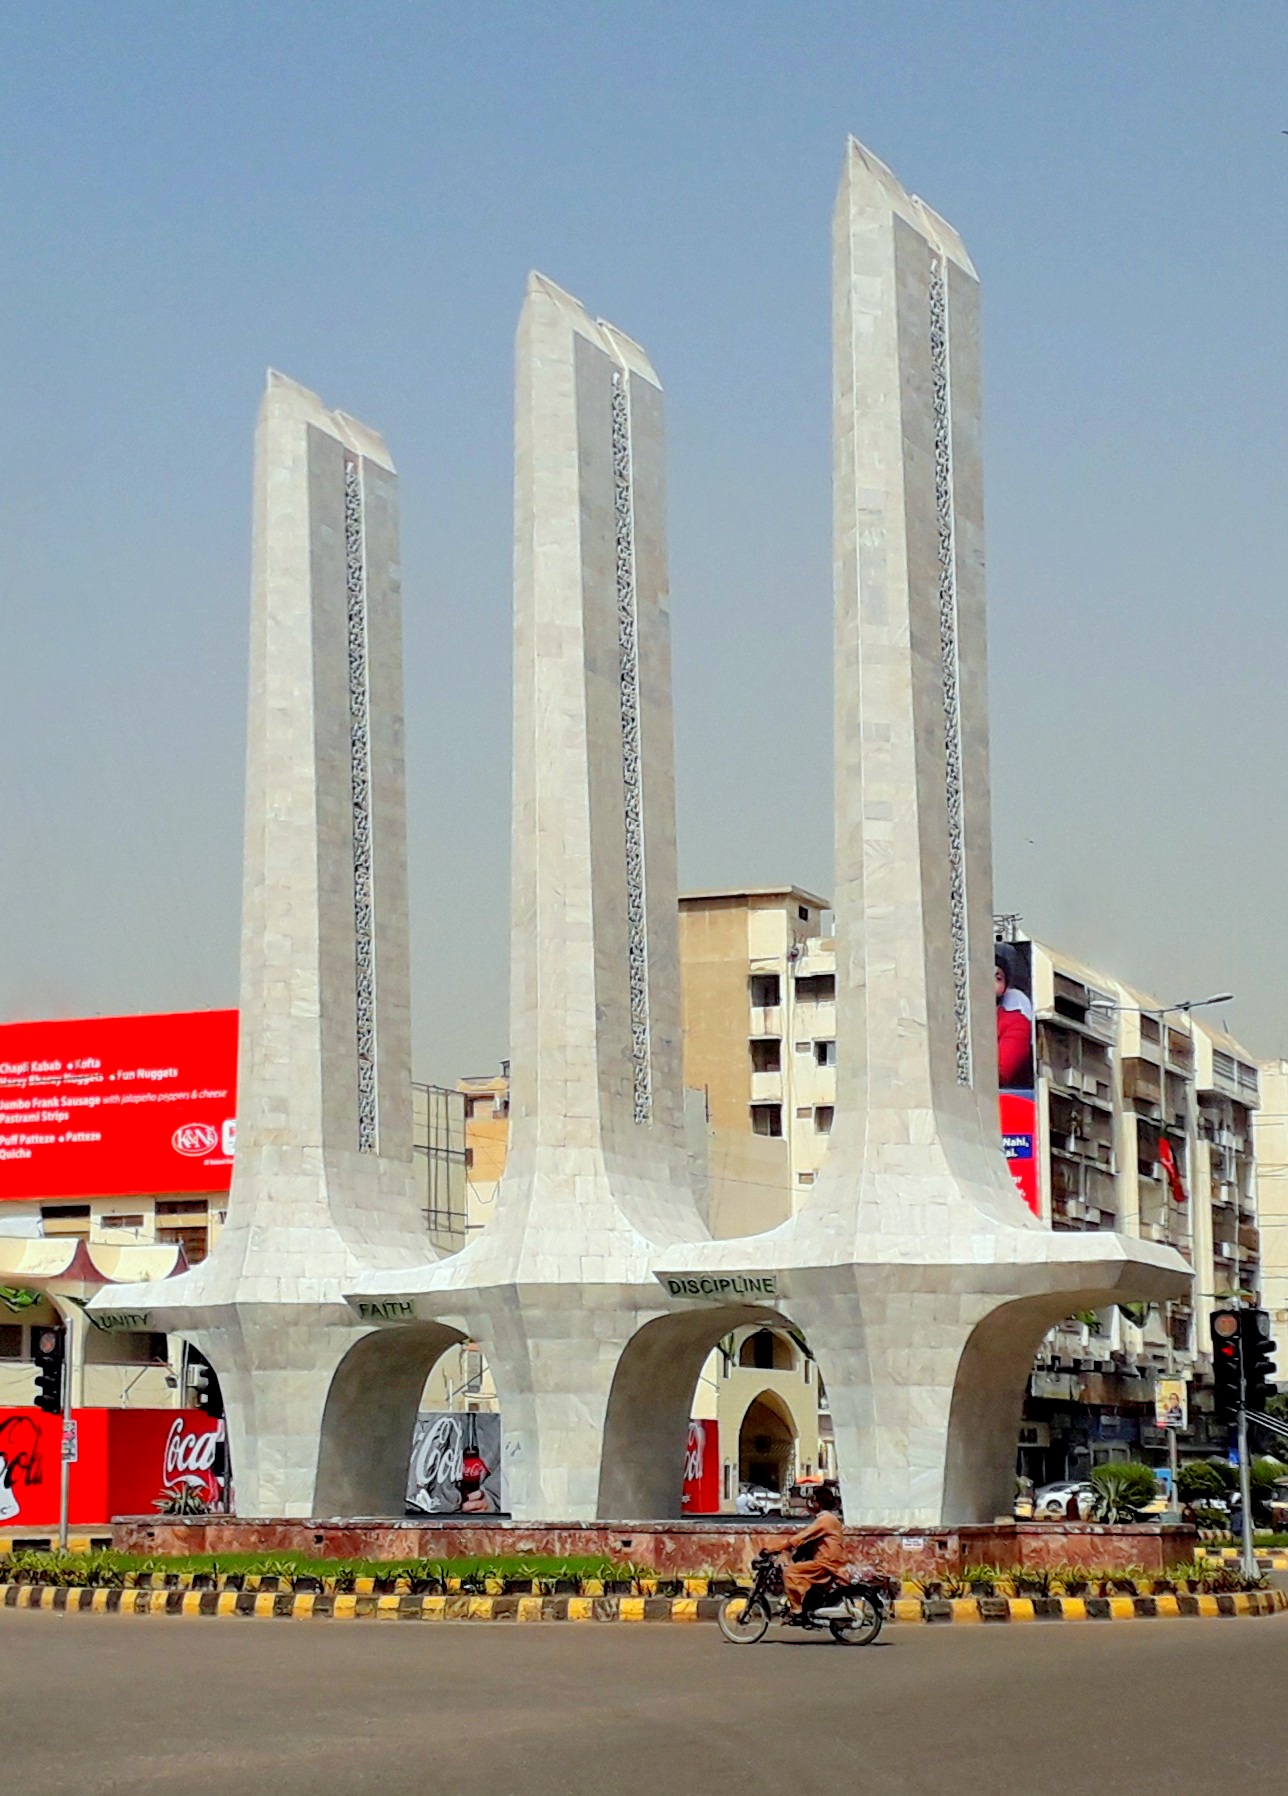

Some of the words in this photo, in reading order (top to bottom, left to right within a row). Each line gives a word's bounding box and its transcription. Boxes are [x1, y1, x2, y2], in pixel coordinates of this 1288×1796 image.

[31, 1060, 62, 1072] Kabab
[75, 1057, 101, 1069] Kofta
[137, 1067, 179, 1081] Nuggets
[32, 1096, 60, 1108] Frank
[61, 1095, 101, 1108] Sausage
[190, 1089, 198, 1100] &
[199, 1088, 228, 1099] cheese
[0, 1112, 40, 1124] Pastrami
[41, 1110, 70, 1123] Strips
[0, 1148, 32, 1160] Quiche
[668, 1278, 775, 1295] DISCIPLINE
[359, 1301, 413, 1319] FAITH
[100, 1313, 148, 1329] UNITY
